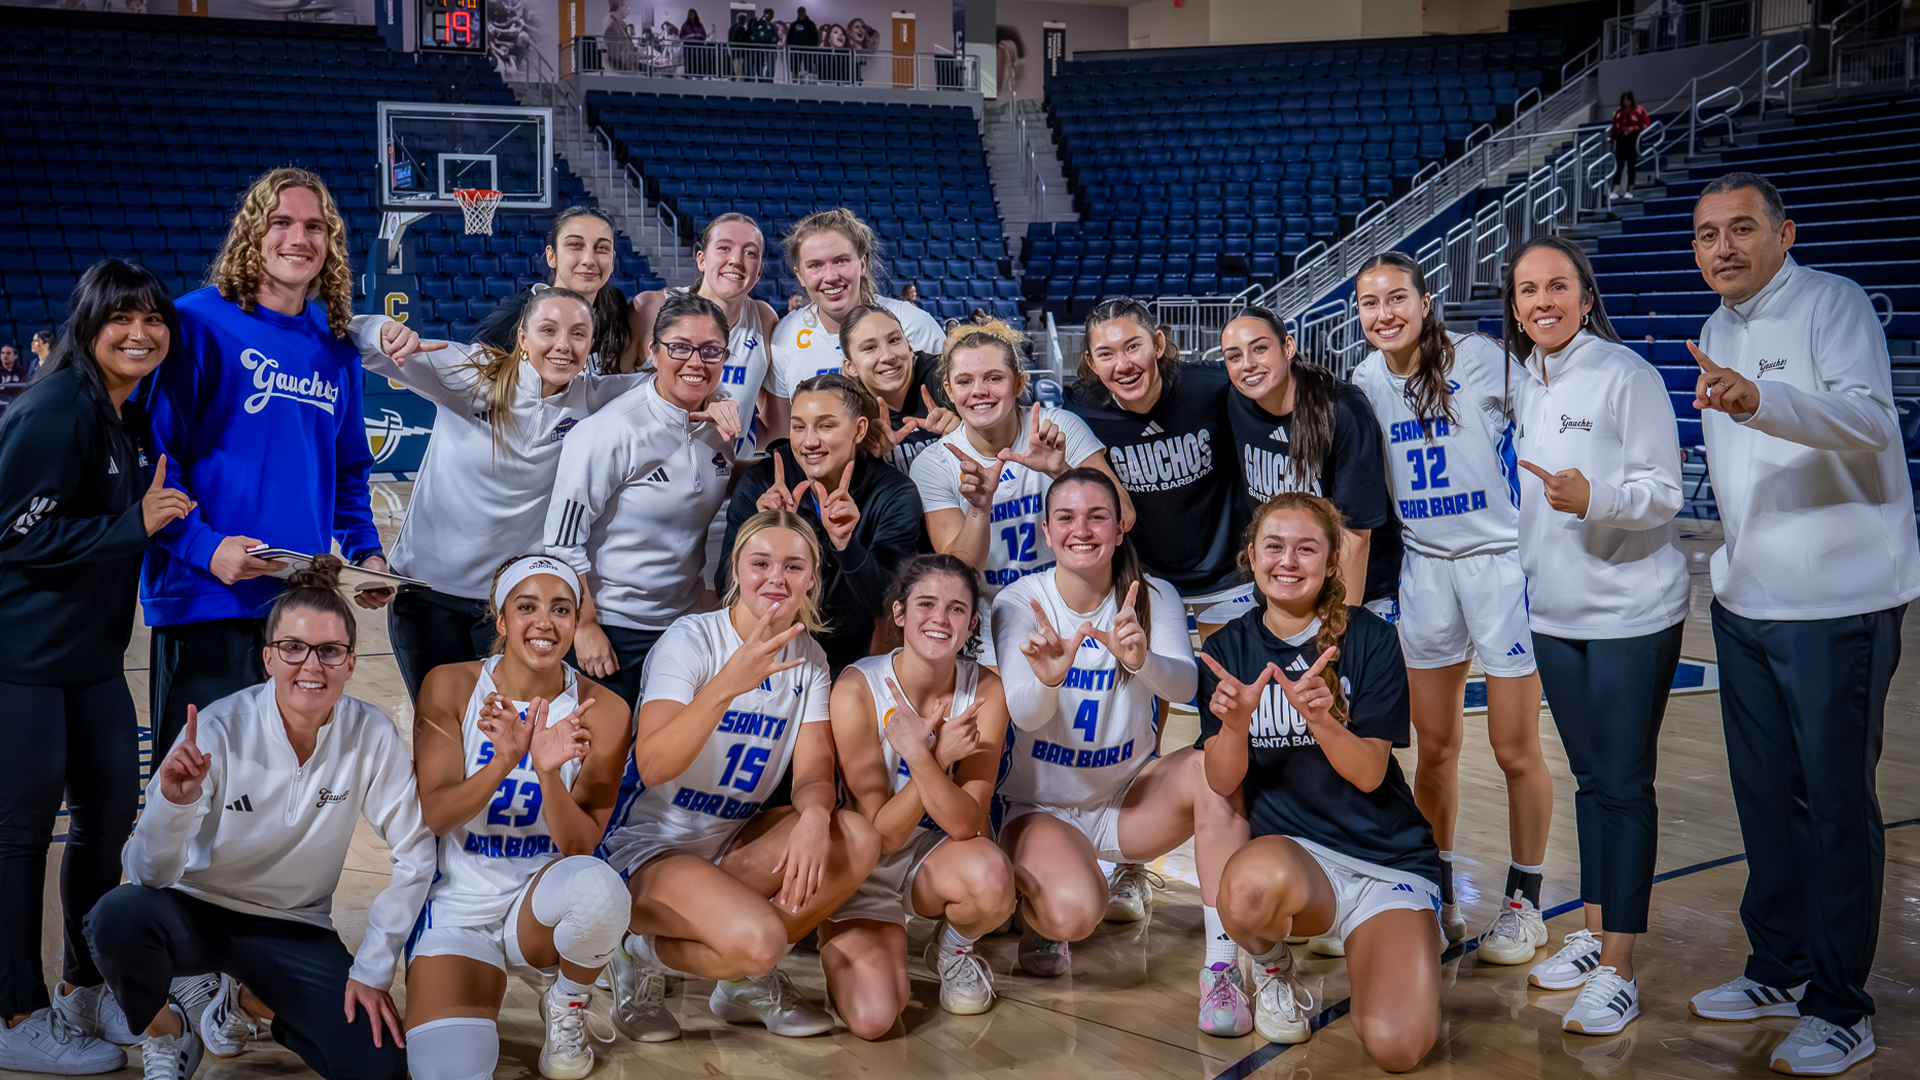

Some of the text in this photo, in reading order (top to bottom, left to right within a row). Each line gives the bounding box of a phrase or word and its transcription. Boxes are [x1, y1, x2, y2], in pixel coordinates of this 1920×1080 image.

[445, 10, 471, 44] 19
[240, 348, 339, 415] Gauchos
[1756, 358, 1788, 379] Gauchos
[1559, 414, 1594, 434] Gauchos
[1110, 428, 1213, 486] GAUCHOS
[1406, 445, 1451, 491] 32
[1121, 465, 1214, 493] SANTA BARBARA
[1397, 489, 1489, 519] BARBARA
[1001, 522, 1038, 562] 12
[528, 563, 559, 571] adidas
[716, 709, 789, 742] SANTA
[1073, 698, 1100, 743] 4
[1031, 738, 1136, 769] BARBARA
[1251, 737, 1290, 749] SANTA
[718, 743, 773, 794] 15
[487, 778, 543, 828] 23
